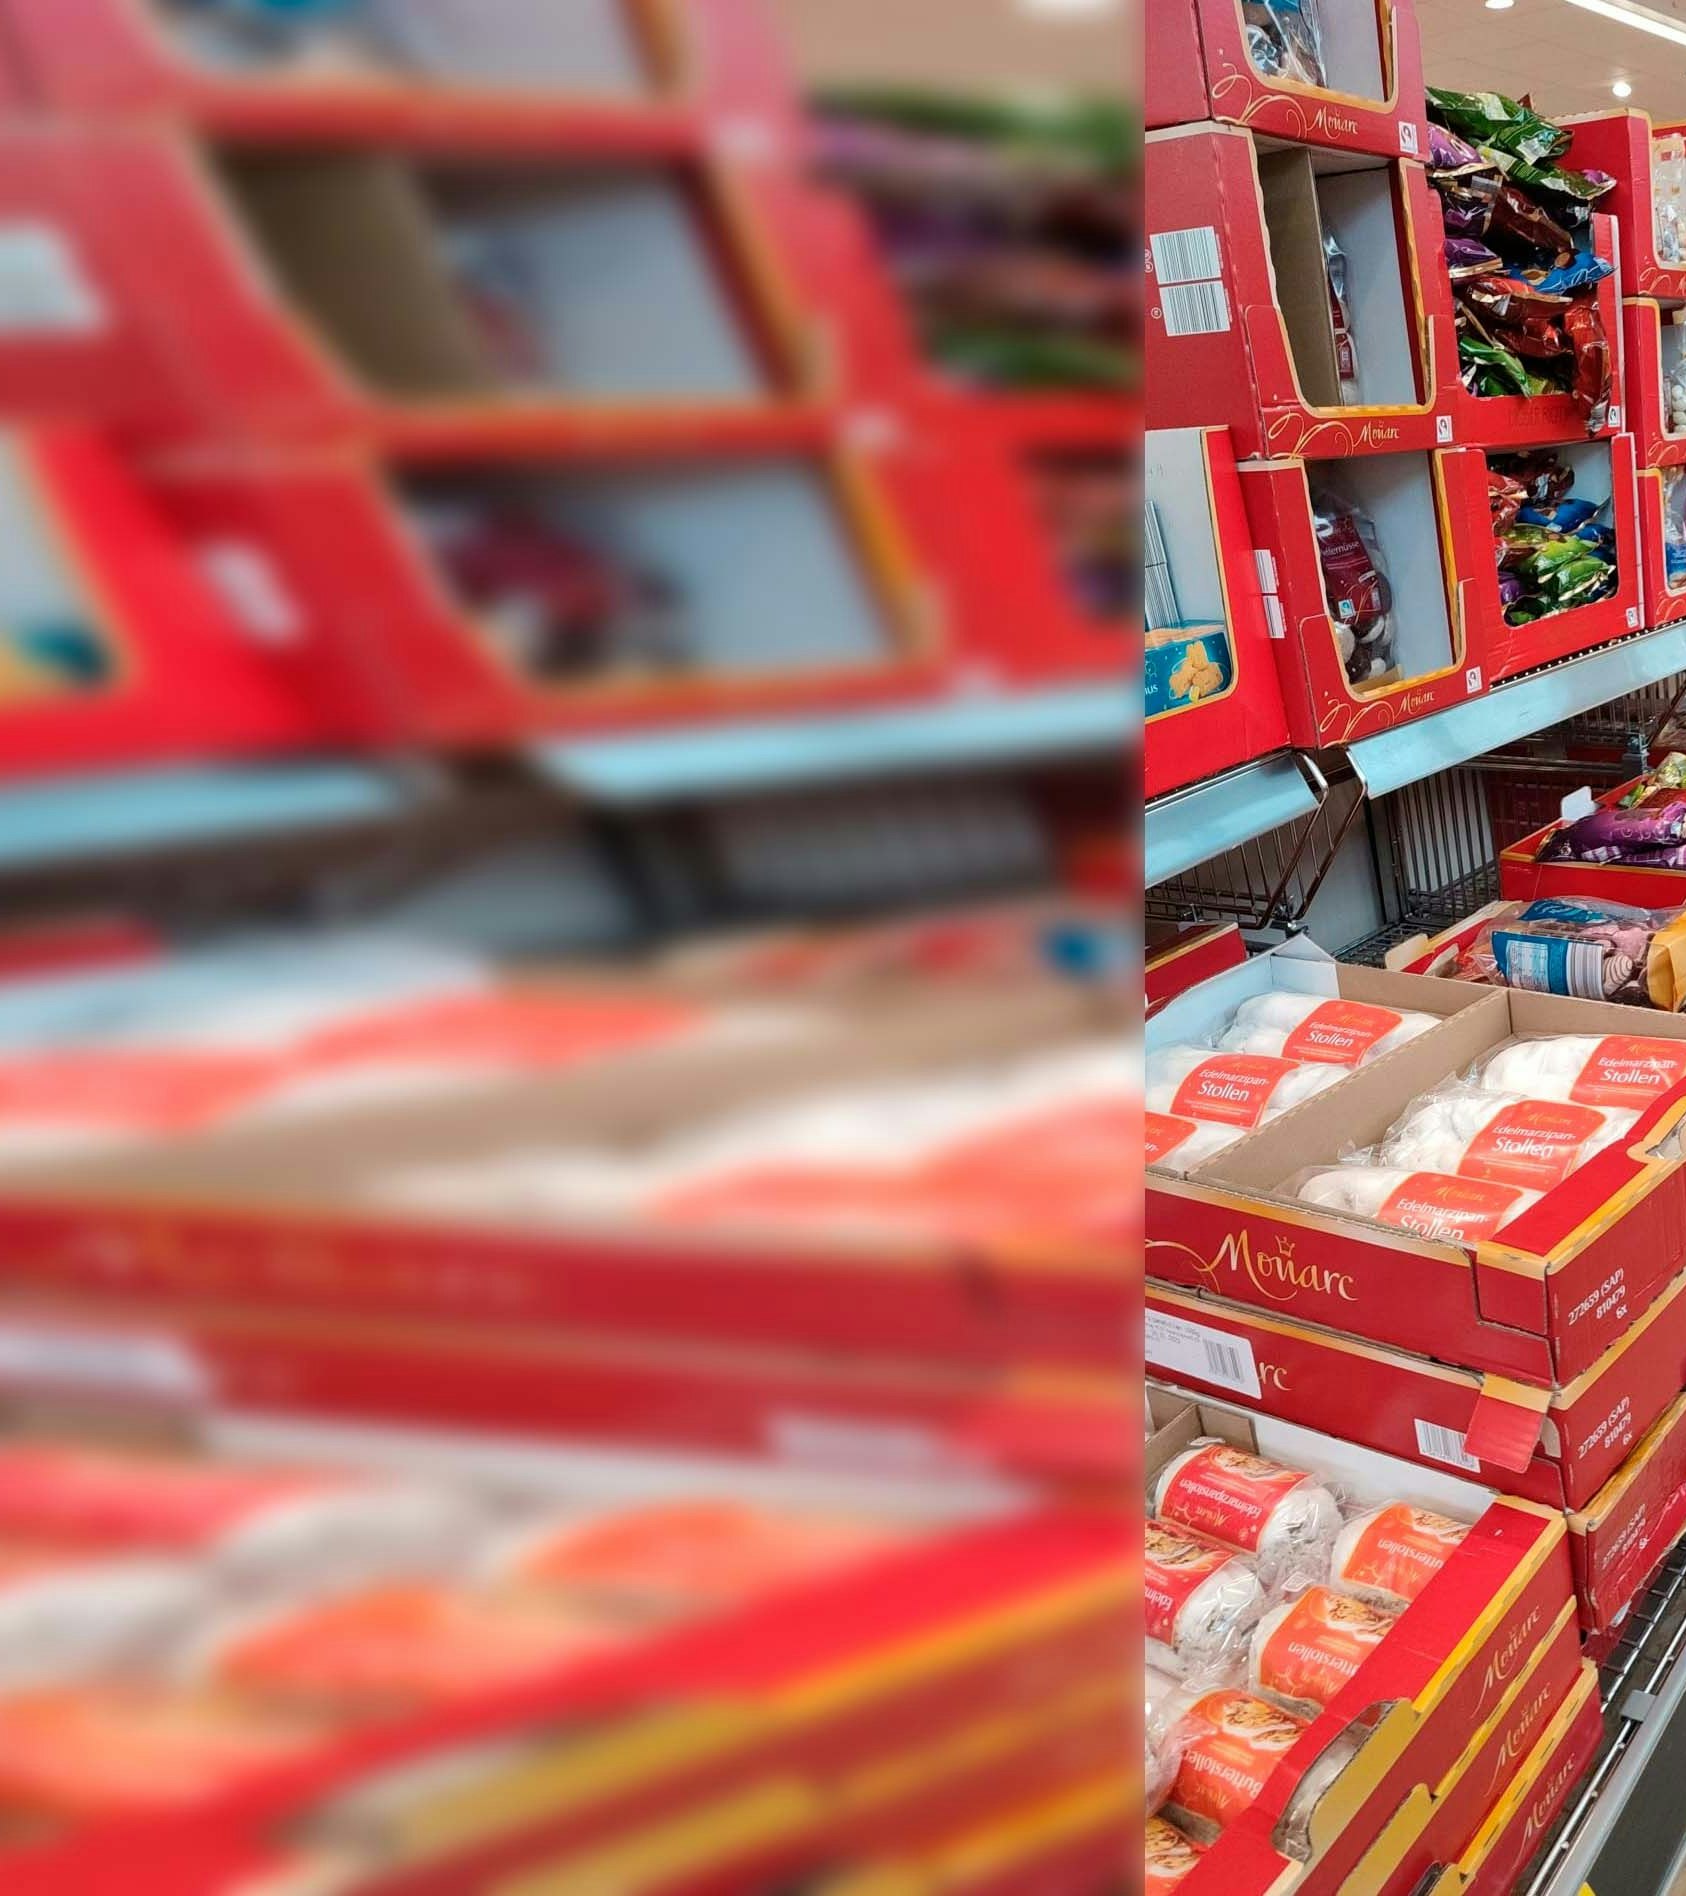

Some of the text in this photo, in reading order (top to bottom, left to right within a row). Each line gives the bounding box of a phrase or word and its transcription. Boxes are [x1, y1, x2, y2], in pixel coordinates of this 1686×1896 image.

[1305, 1030, 1355, 1048] Stollen
[1600, 1068, 1661, 1085] Stollen
[1196, 1079, 1250, 1102] Stollen
[1491, 1136, 1554, 1160] Stollen
[1600, 1267, 1624, 1297] (SAP)
[1607, 1396, 1630, 1427] (SAP)
[1377, 1538, 1445, 1570] utterstollen
